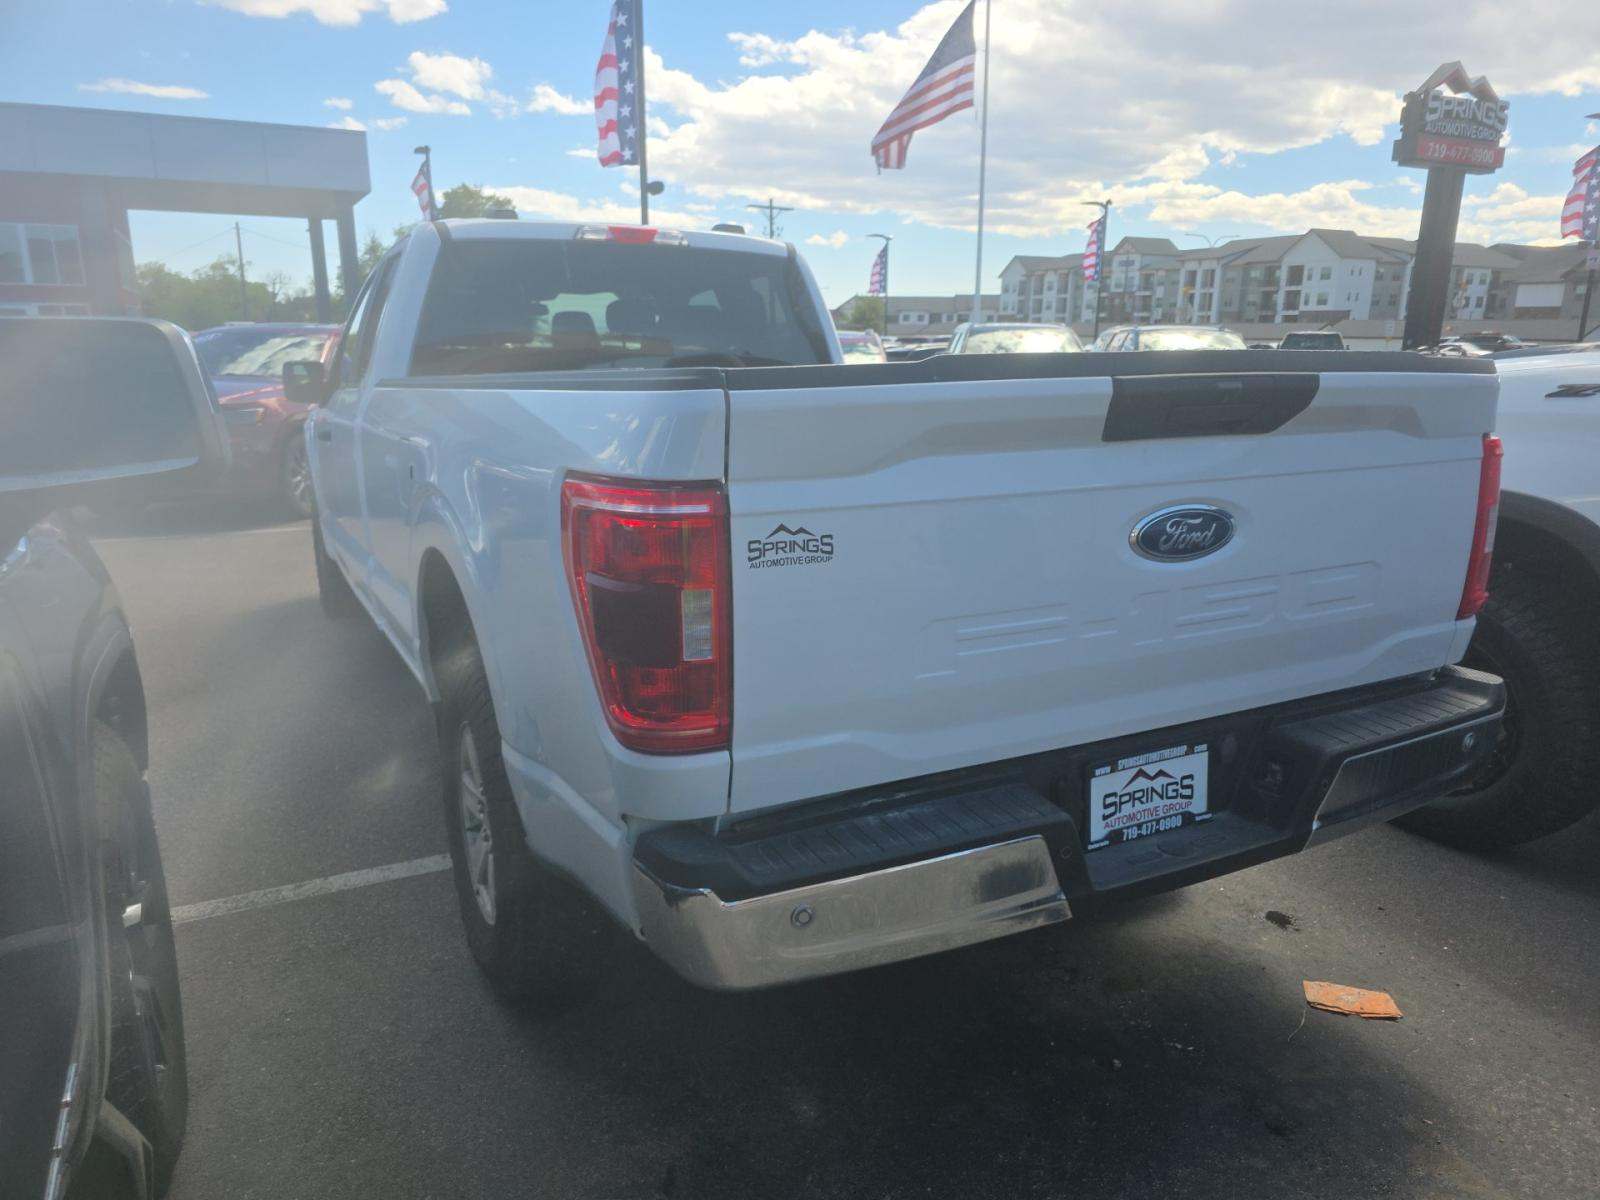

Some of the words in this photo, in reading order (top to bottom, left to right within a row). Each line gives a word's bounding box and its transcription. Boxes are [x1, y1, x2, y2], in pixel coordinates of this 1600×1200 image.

[1425, 89, 1511, 132] SPRINGS
[1425, 120, 1477, 138] AUTOMOTIVE
[747, 534, 834, 562] SPRINGS
[1159, 517, 1216, 551] Ford
[749, 556, 804, 569] AUTOMOTIVE
[804, 555, 833, 565] GROUP
[1102, 773, 1194, 821] SPRINGS
[1103, 806, 1161, 829] AUTOMOTIVE
[1161, 800, 1193, 815] GROUP
